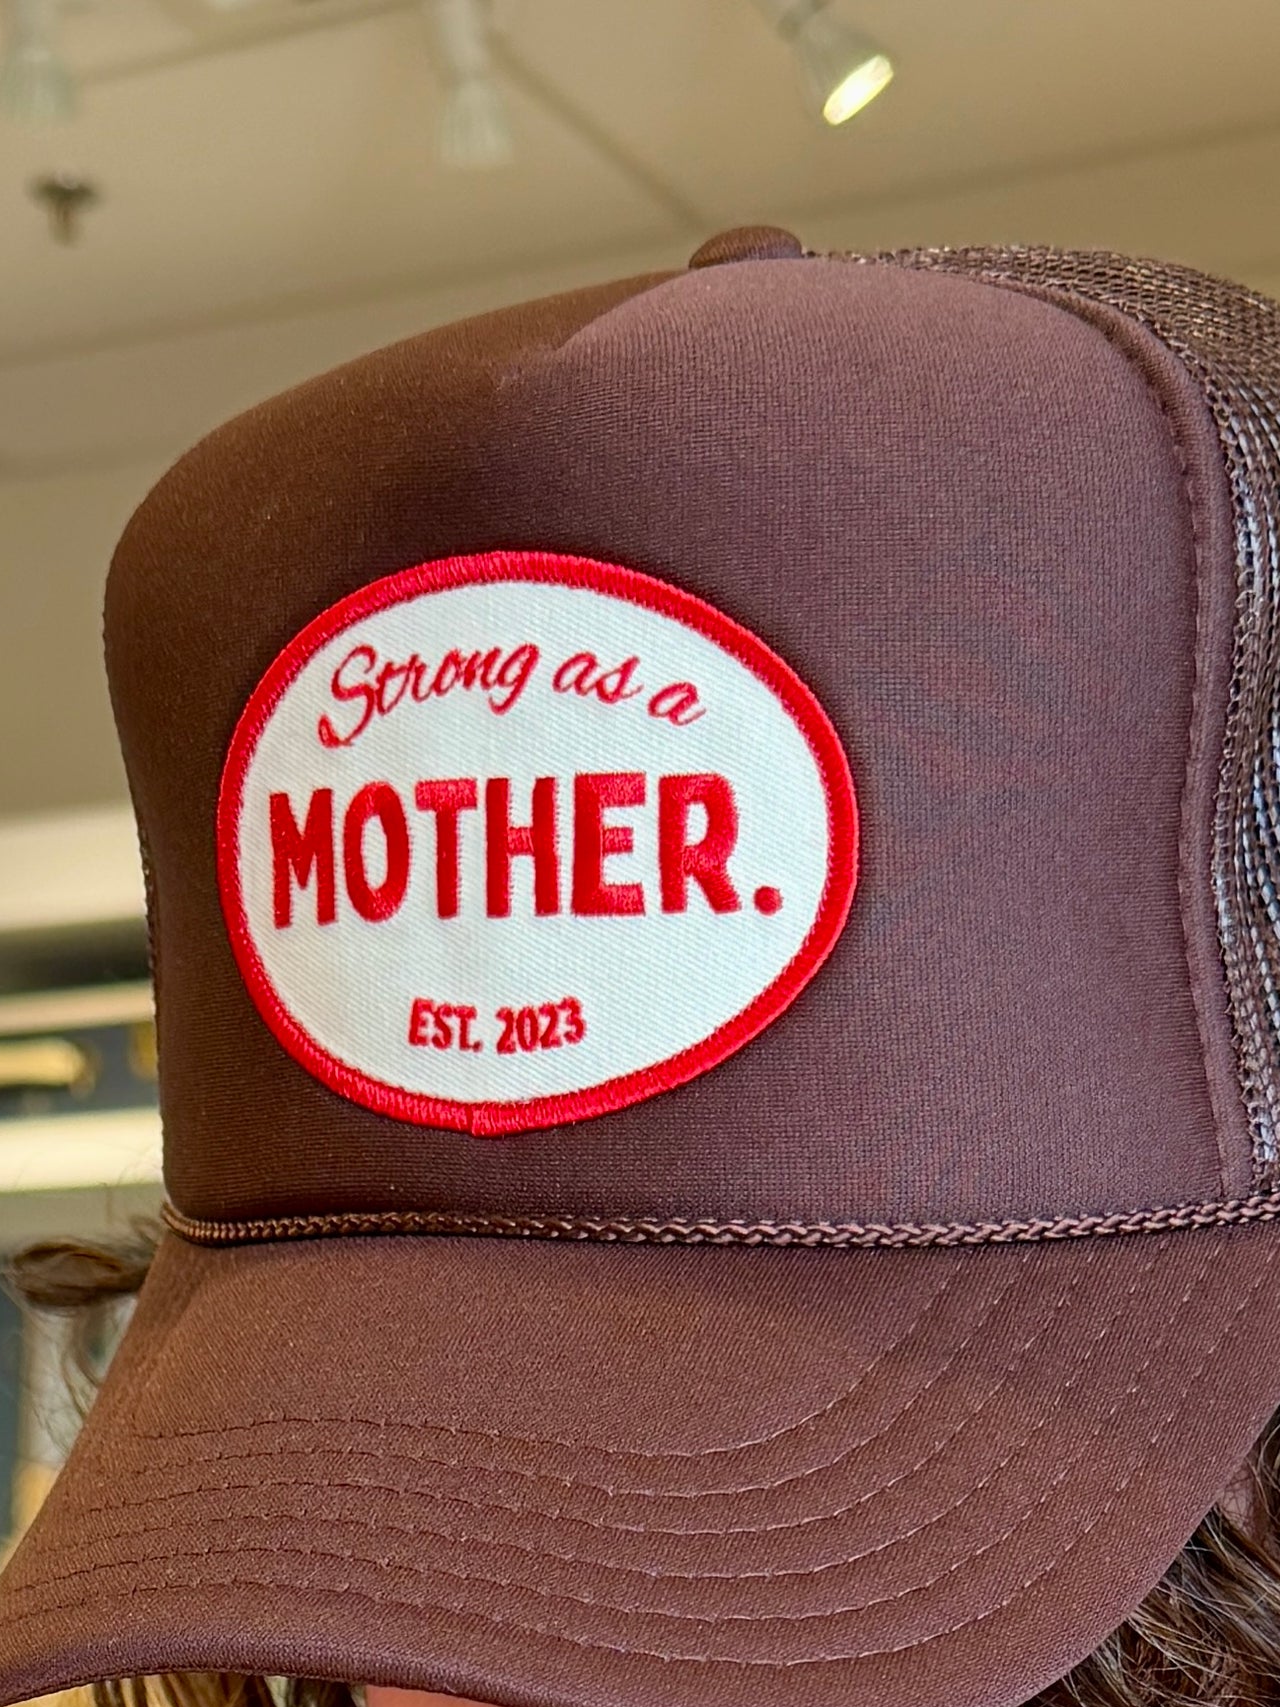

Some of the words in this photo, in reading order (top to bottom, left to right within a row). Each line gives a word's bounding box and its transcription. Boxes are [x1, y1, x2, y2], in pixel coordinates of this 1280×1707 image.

[317, 643, 540, 749] Strong
[552, 651, 644, 705] as
[646, 680, 706, 727] a
[268, 771, 784, 931] MOTHER.
[407, 997, 483, 1053] EST.
[495, 996, 587, 1056] 2023
